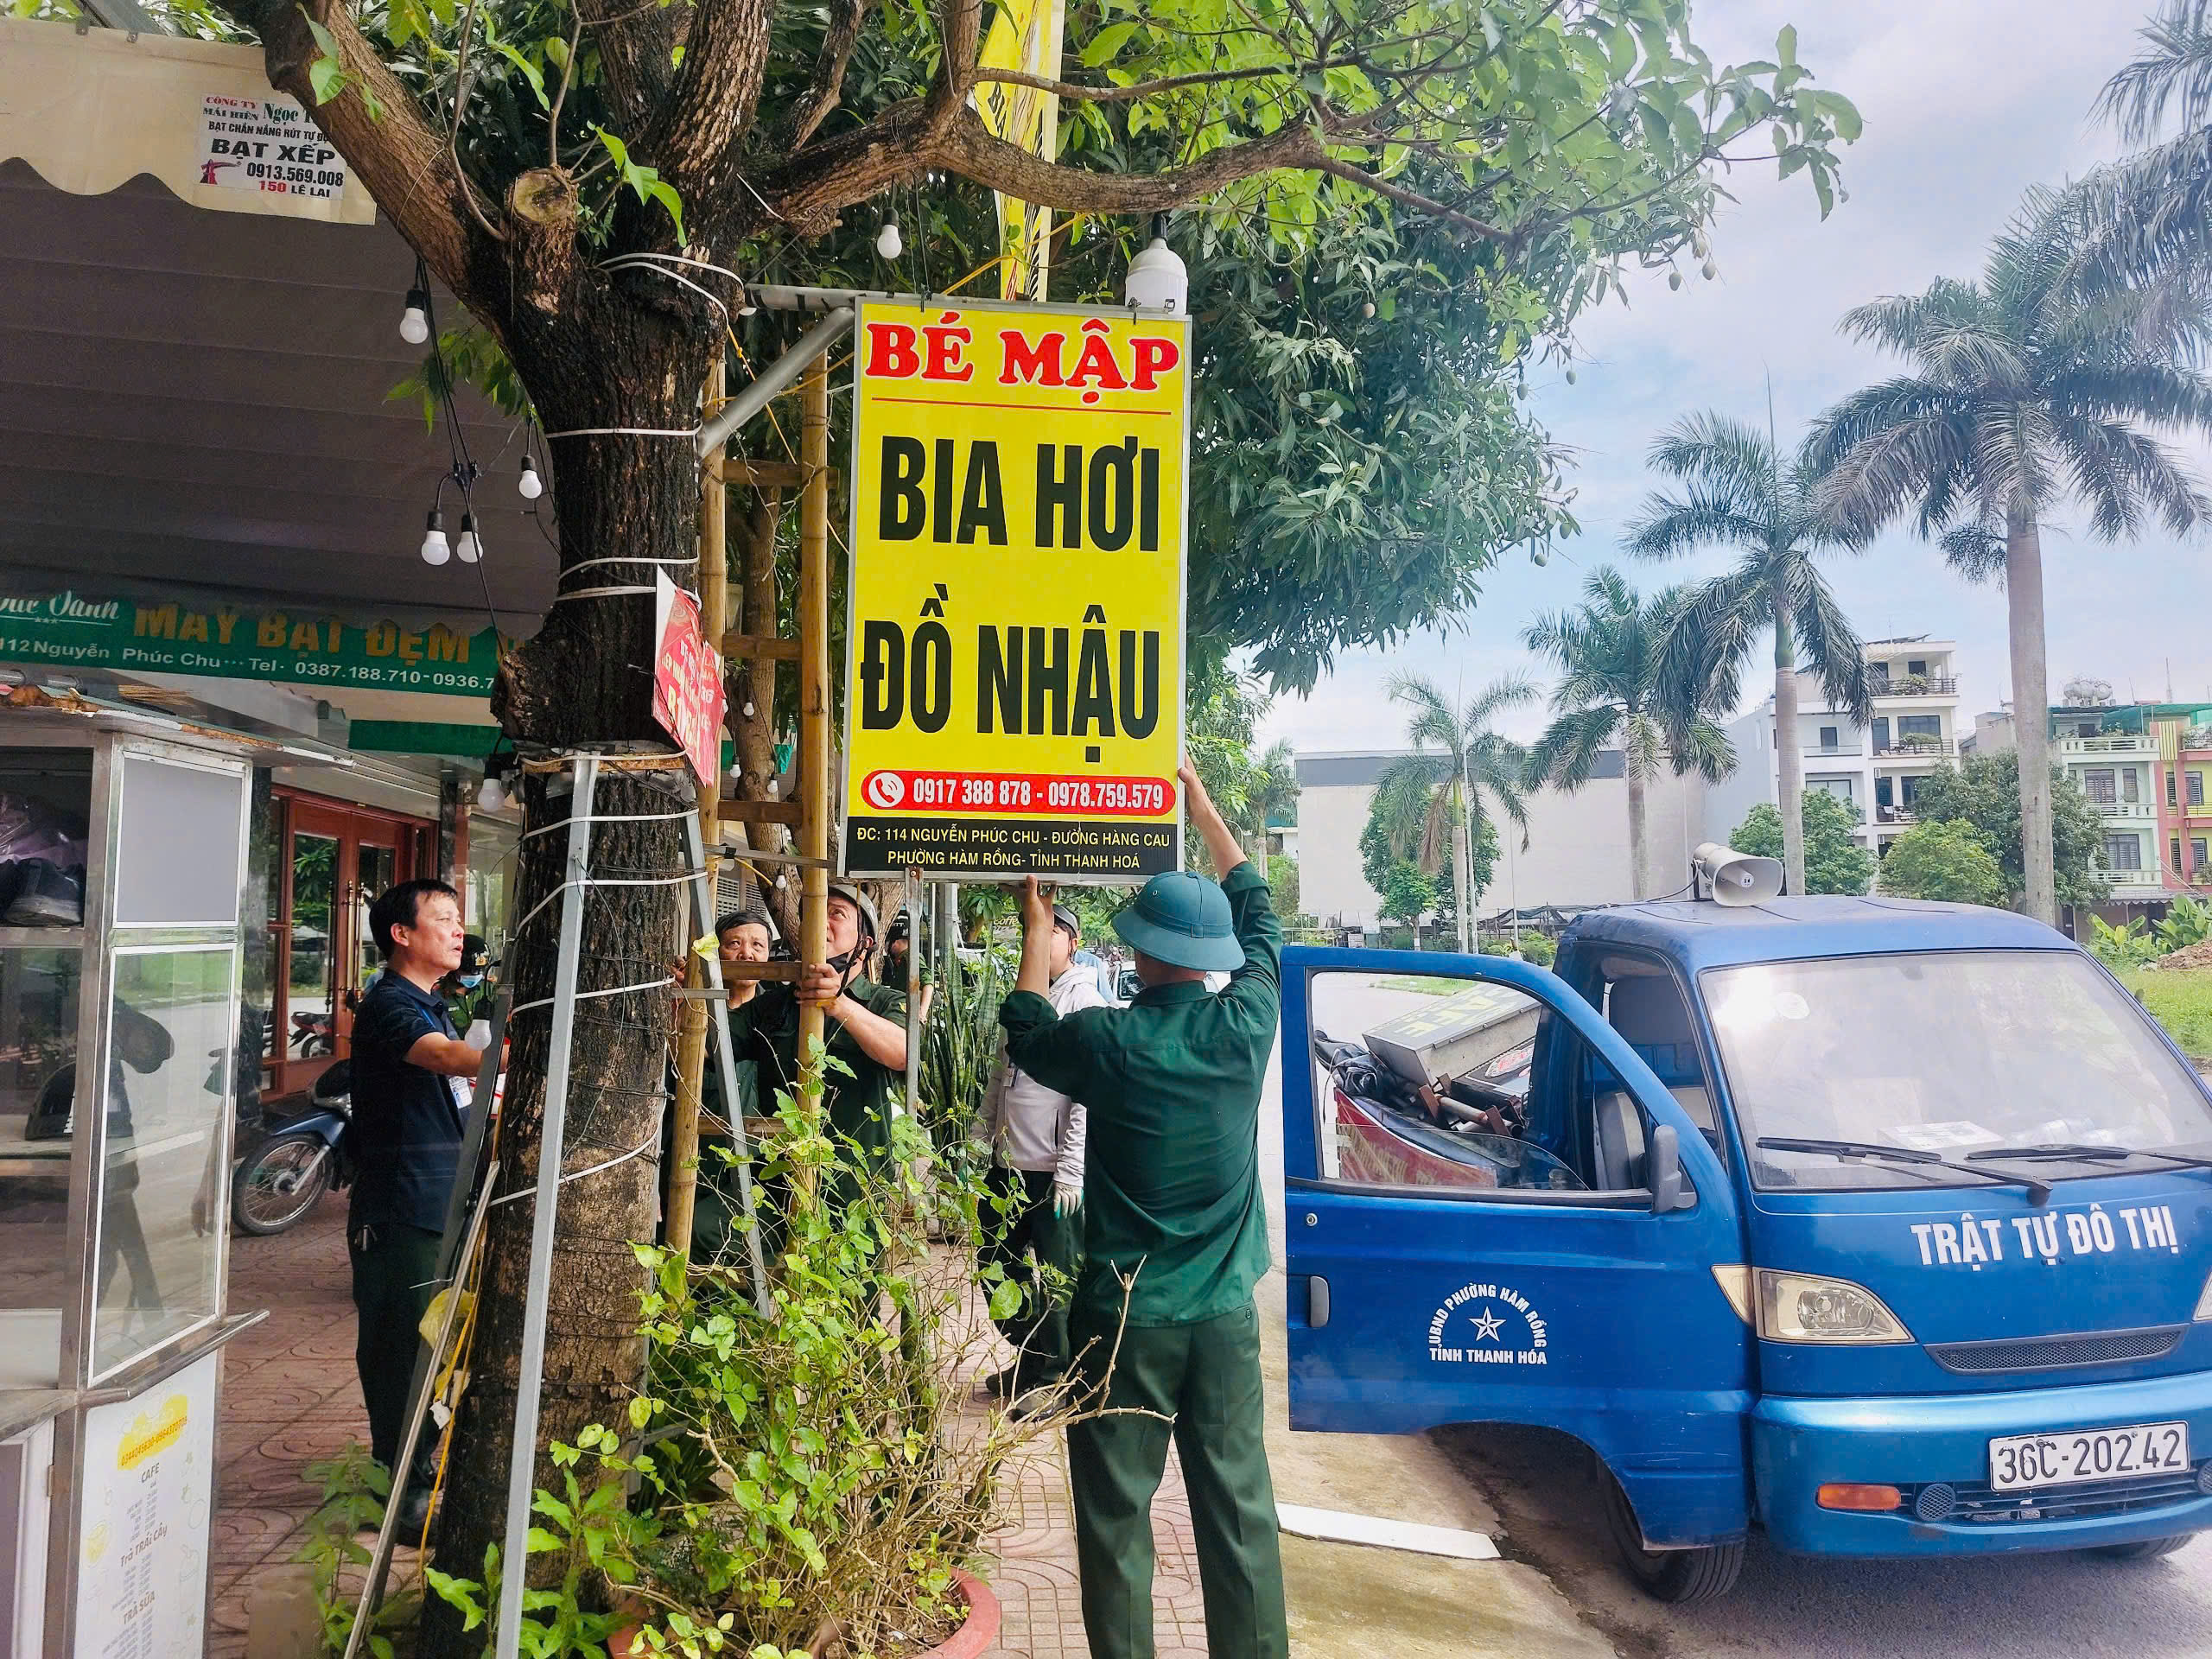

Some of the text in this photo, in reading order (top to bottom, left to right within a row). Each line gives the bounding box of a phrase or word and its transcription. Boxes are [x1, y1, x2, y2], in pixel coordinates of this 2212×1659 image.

[203, 107, 226, 117] MÁI
[207, 96, 257, 109] CÔNG TY
[263, 103, 299, 125] Ngọc
[208, 121, 226, 132] BẠT
[283, 128, 301, 138] RÚT
[304, 131, 315, 142] TỰ
[211, 138, 335, 165] BẠT XẾP
[246, 162, 344, 187] 0913.569.008
[259, 181, 330, 198] 150 LÊ LAI
[865, 312, 1179, 404] BÉ MẬP
[879, 435, 1160, 551] BIA HƠI
[134, 601, 238, 645] MAY
[34, 642, 110, 659] Nguyễn
[123, 649, 173, 664] Phúc
[180, 653, 220, 667] Chu
[295, 661, 495, 690] 0387.188.710-0936.7
[861, 583, 952, 733] ĐỒ
[977, 605, 1160, 762] NHẬU
[913, 779, 956, 804] 0917
[962, 780, 994, 804] 388
[999, 781, 1031, 805] 878
[1048, 782, 1163, 809] 0978.759.579
[857, 827, 880, 841] ĐC:
[886, 829, 907, 841] 114
[911, 823, 967, 842] NGUYỄN
[971, 827, 1007, 843] PHÚC
[1012, 830, 1039, 844] CHU
[1052, 828, 1098, 845] ĐƯỜNG
[1103, 830, 1140, 846] HÀNG
[1144, 833, 1170, 848] CAU
[888, 849, 944, 865] PHƯỜNG
[950, 849, 978, 866] HÀM
[1030, 849, 1058, 868] TỈNH
[1064, 854, 1109, 868] THANH
[1113, 852, 1141, 869] HOÁ
[1910, 1202, 2179, 1272] TRẬT TỰ ĐÔ THỊ
[1428, 1308, 1449, 1344] UBND
[1444, 1282, 1497, 1311] PHƯỜNG
[1499, 1287, 1530, 1313] HÀM
[1429, 1344, 1547, 1364] TỈNH THANH HÓA
[1998, 1429, 2182, 1484] 36C-202.42
